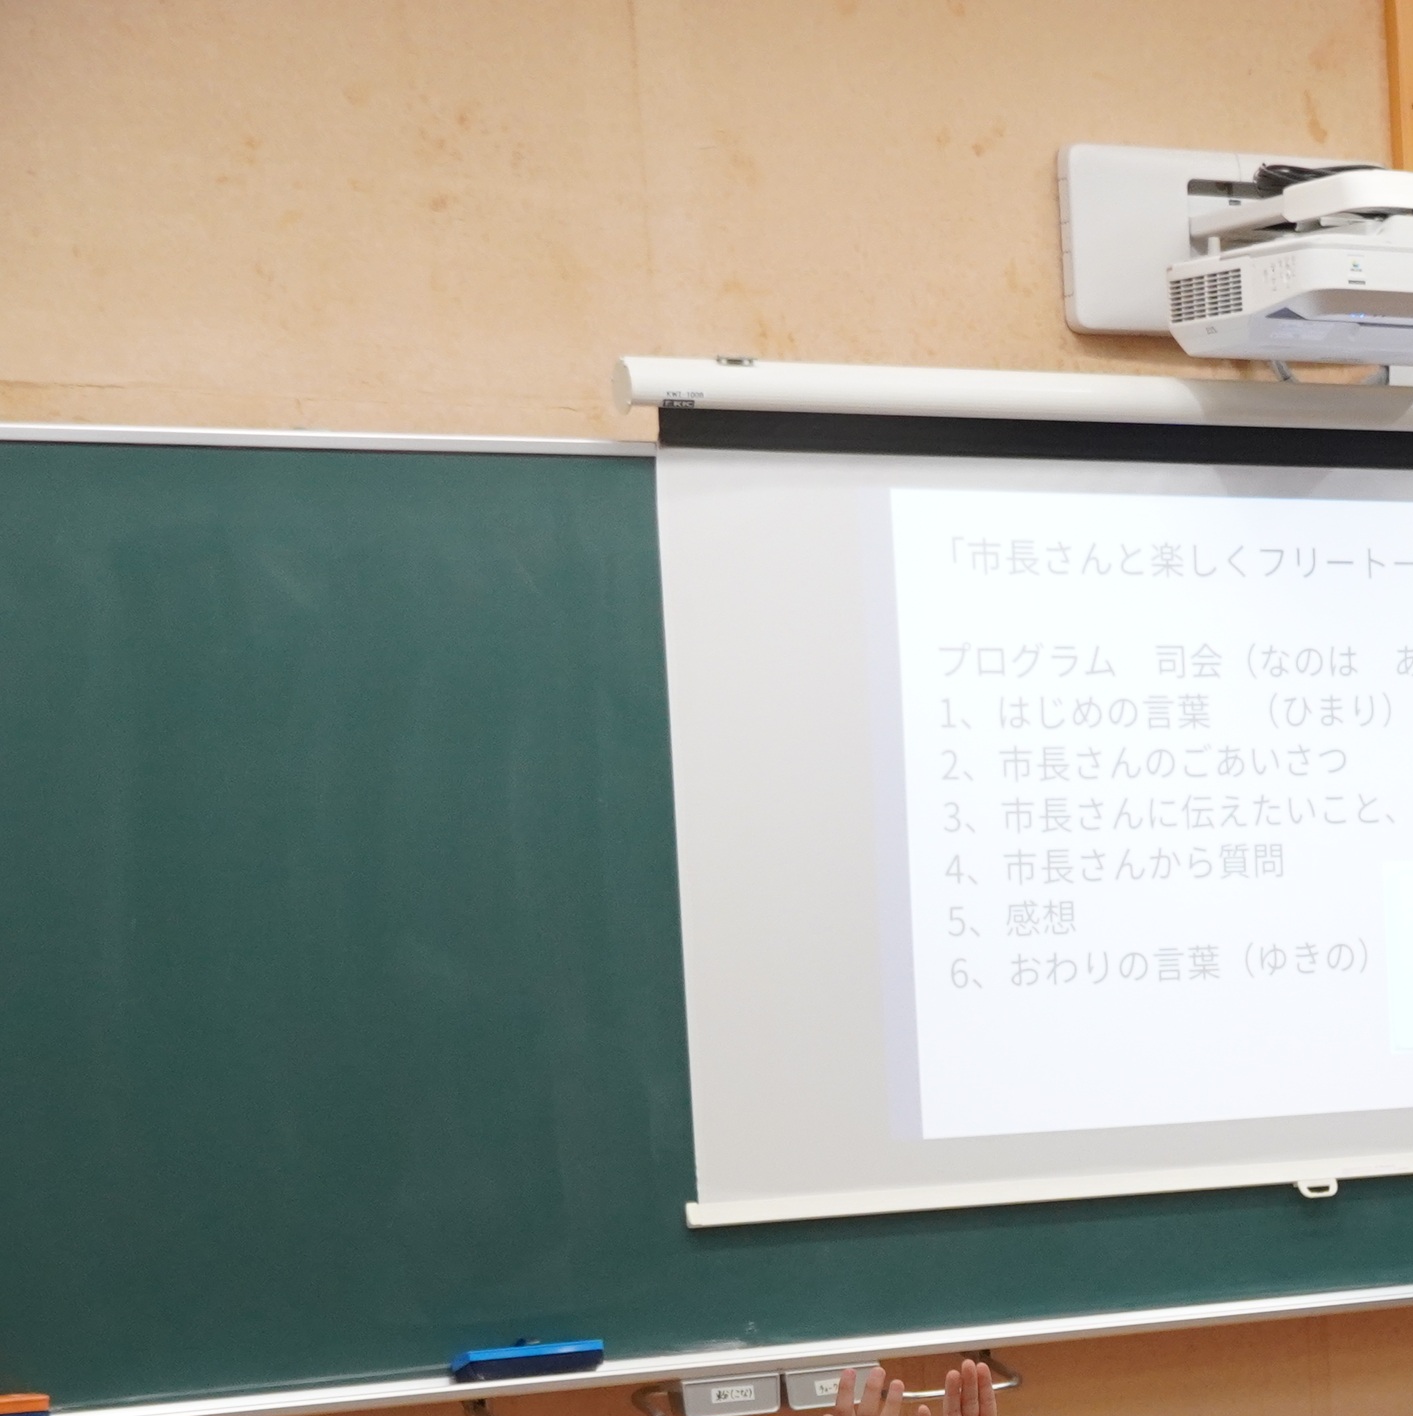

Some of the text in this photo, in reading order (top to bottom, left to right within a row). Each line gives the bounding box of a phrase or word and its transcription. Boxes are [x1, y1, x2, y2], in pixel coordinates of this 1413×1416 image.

[938, 642, 1116, 678] プログラム
[941, 744, 1347, 783] 2、市長さんのごあいさつ
[944, 843, 1285, 886] 4、市長さんから質問
[948, 899, 1076, 938] 5、感想
[950, 937, 1369, 990] 6、おわりの言葉（ゆきの）
